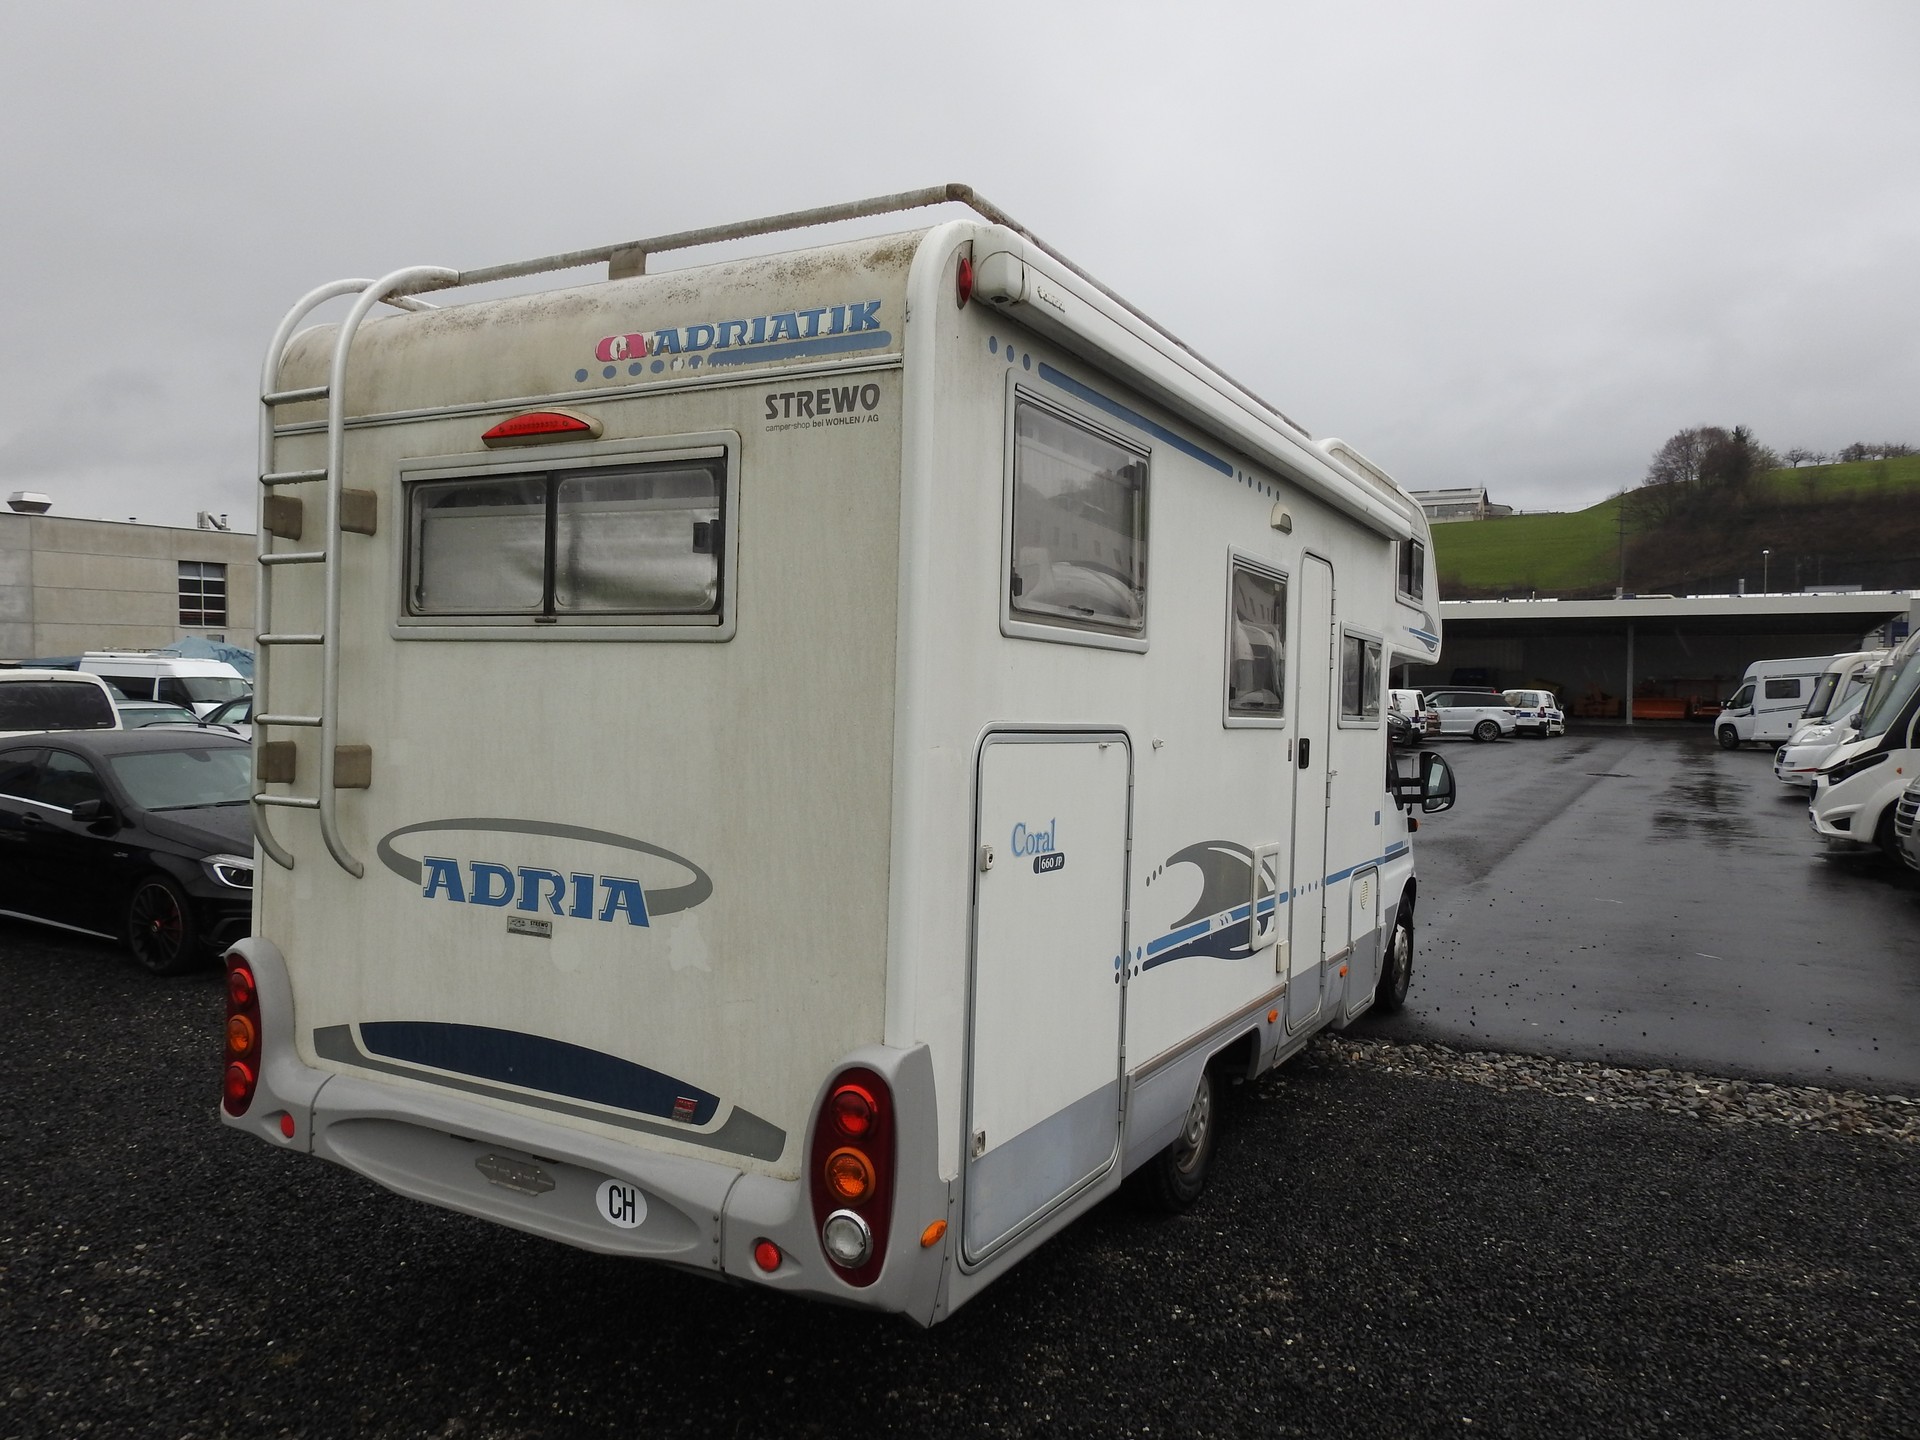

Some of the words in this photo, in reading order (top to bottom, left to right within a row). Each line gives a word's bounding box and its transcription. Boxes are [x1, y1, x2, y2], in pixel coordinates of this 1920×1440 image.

[651, 300, 882, 357] ADRIATIK
[765, 383, 881, 420] STREWO
[765, 421, 811, 433] camper-shop
[825, 416, 861, 427] WOHLEN
[867, 413, 879, 424] AG
[1011, 817, 1056, 858] Coral
[1041, 857, 1055, 870] 660
[422, 855, 650, 928] ADRIA
[608, 1184, 636, 1224] CH
